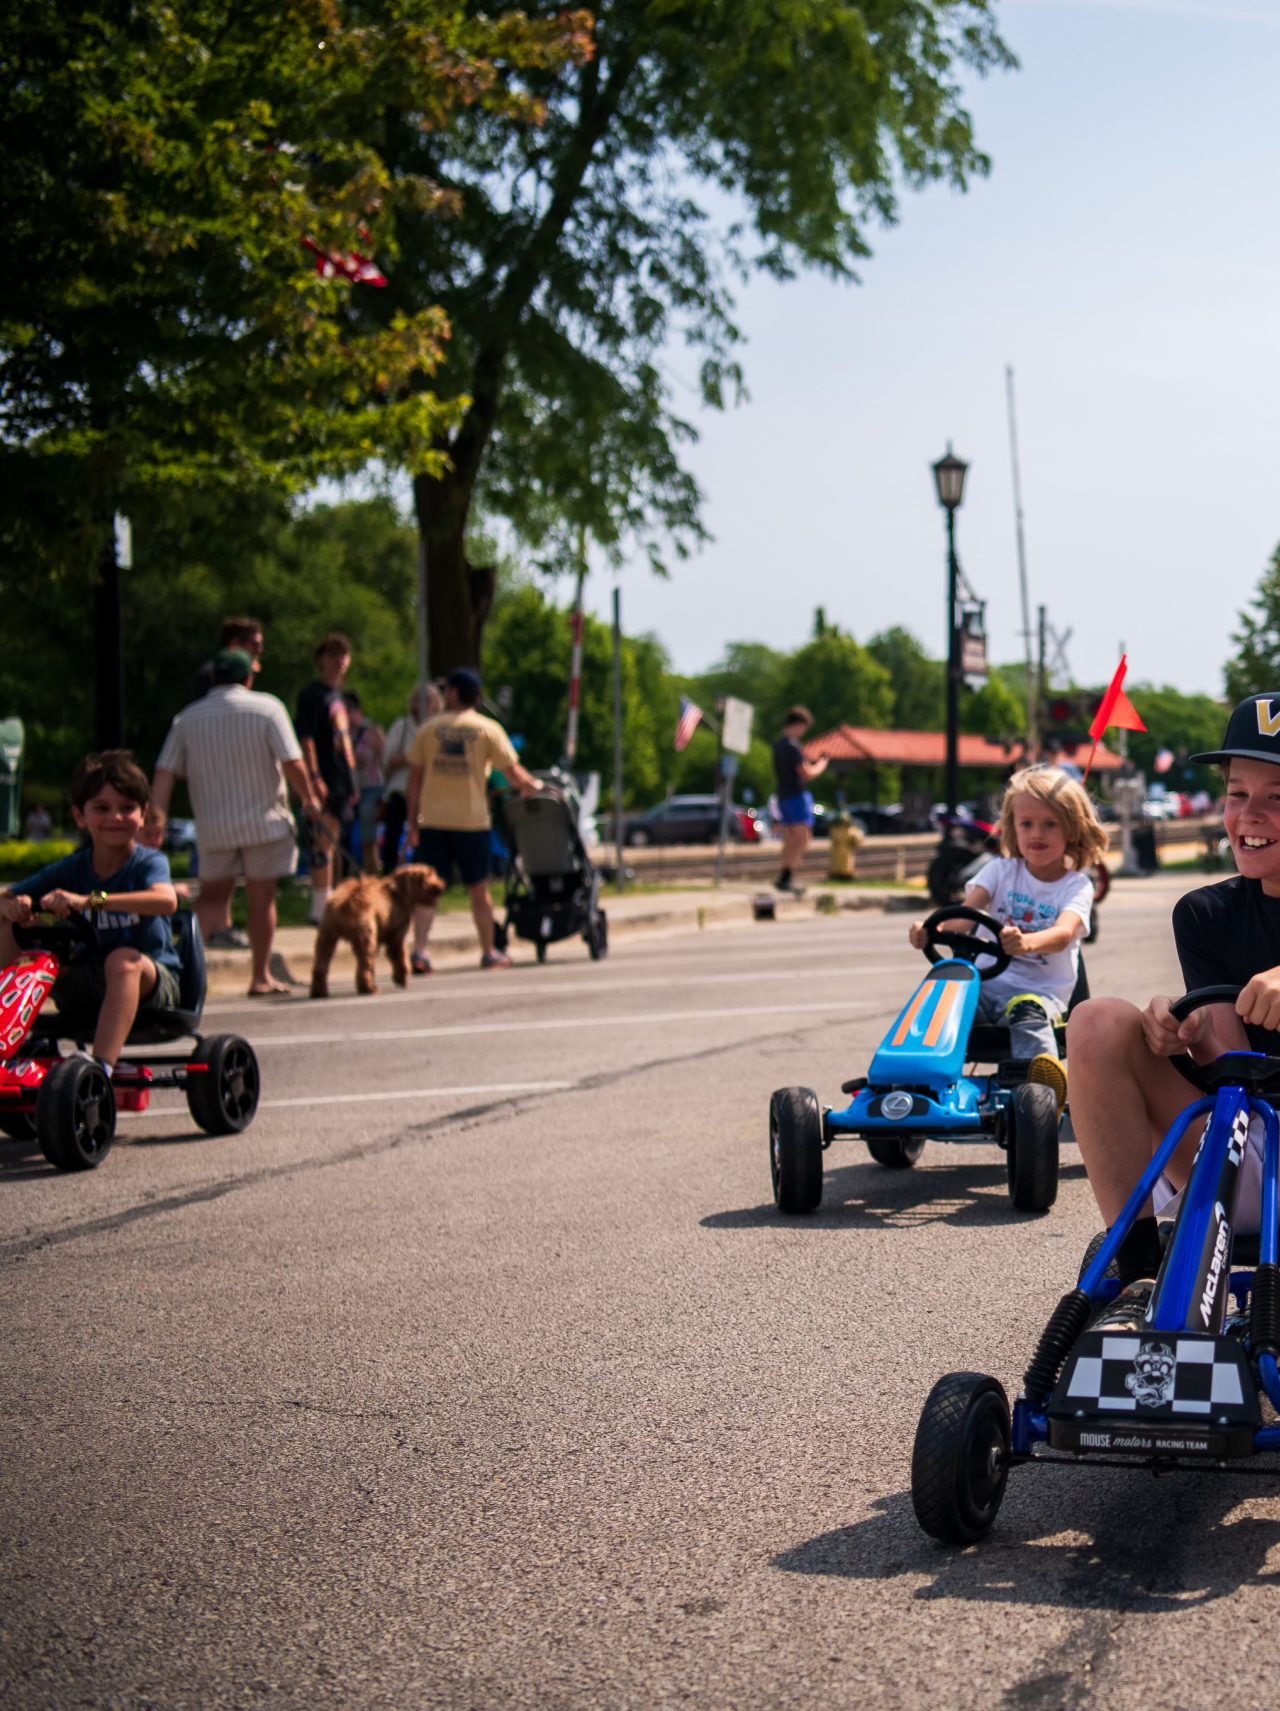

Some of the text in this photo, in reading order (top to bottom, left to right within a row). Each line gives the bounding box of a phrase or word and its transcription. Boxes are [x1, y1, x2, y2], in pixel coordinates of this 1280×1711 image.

[1200, 1219, 1229, 1327] McLaren
[1080, 1433, 1208, 1450] MOUSE motors RACING TEAM
